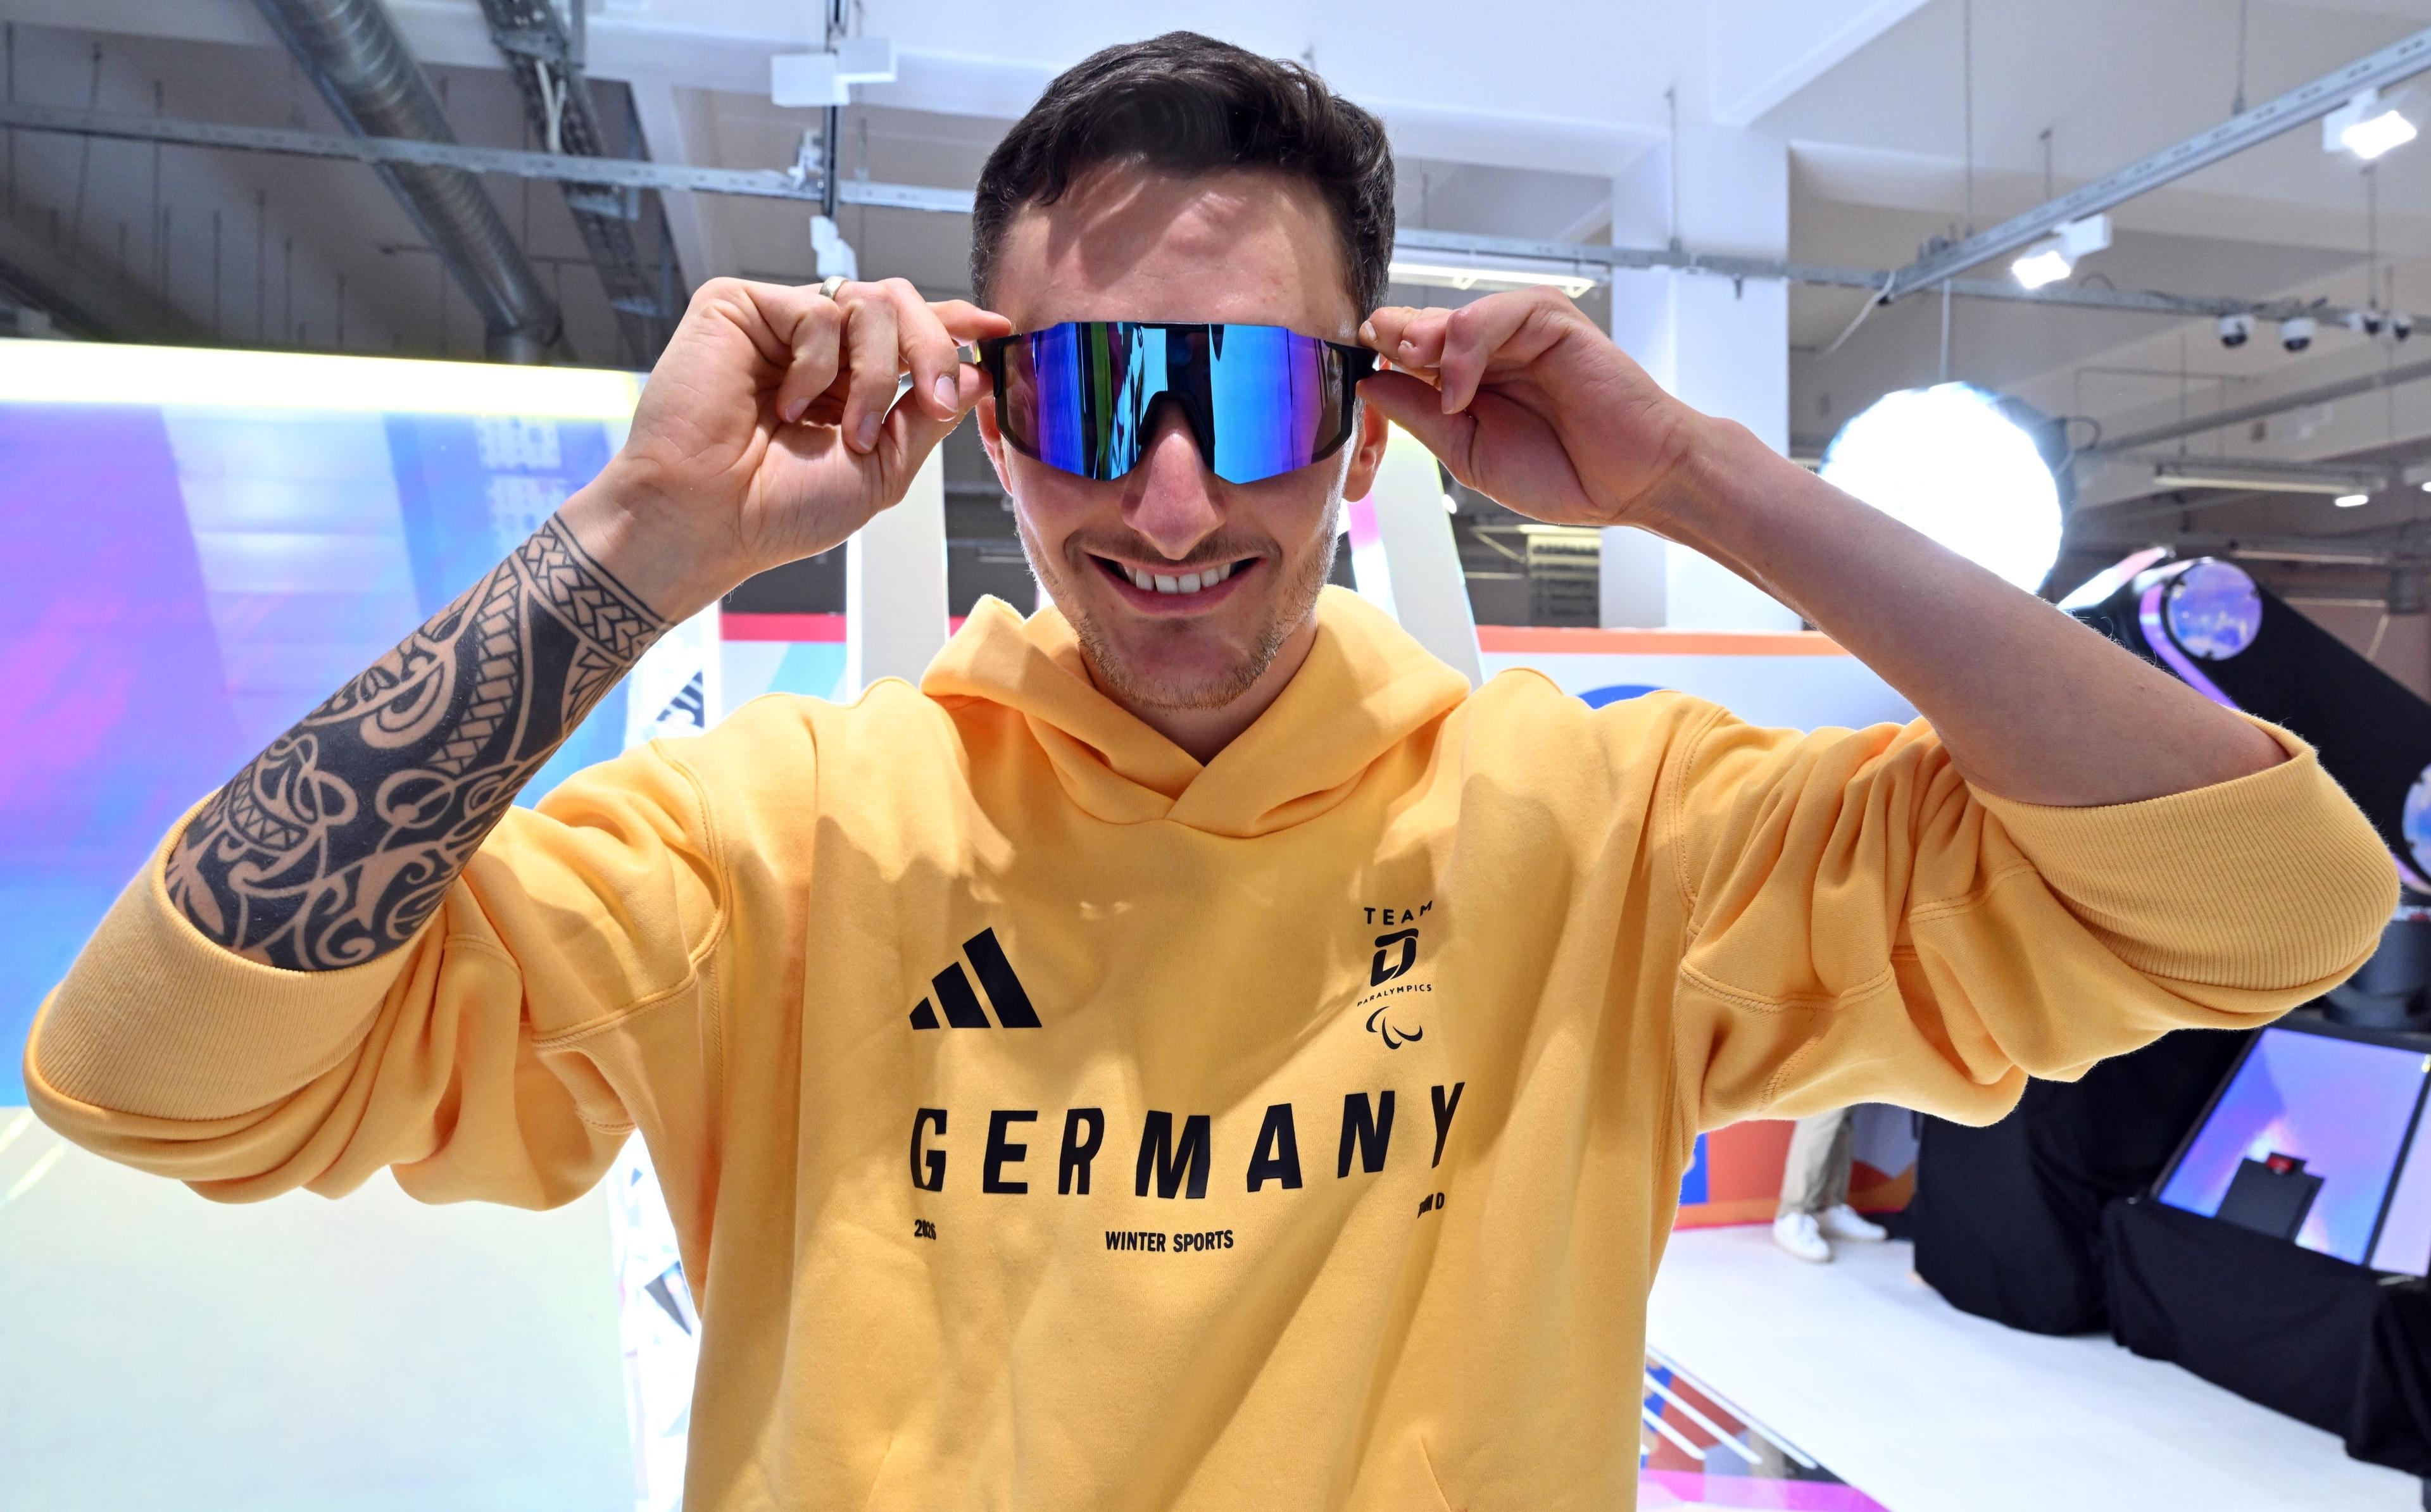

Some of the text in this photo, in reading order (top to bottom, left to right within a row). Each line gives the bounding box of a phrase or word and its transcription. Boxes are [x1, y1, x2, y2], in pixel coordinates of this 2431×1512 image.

[1364, 900, 1433, 926] TEAM
[1357, 984, 1433, 1007] PARALYMPICS
[909, 1081, 1466, 1200] GERMANY
[914, 1218, 937, 1240] 2026
[1105, 1229, 1234, 1253] WINTER SPORTS
